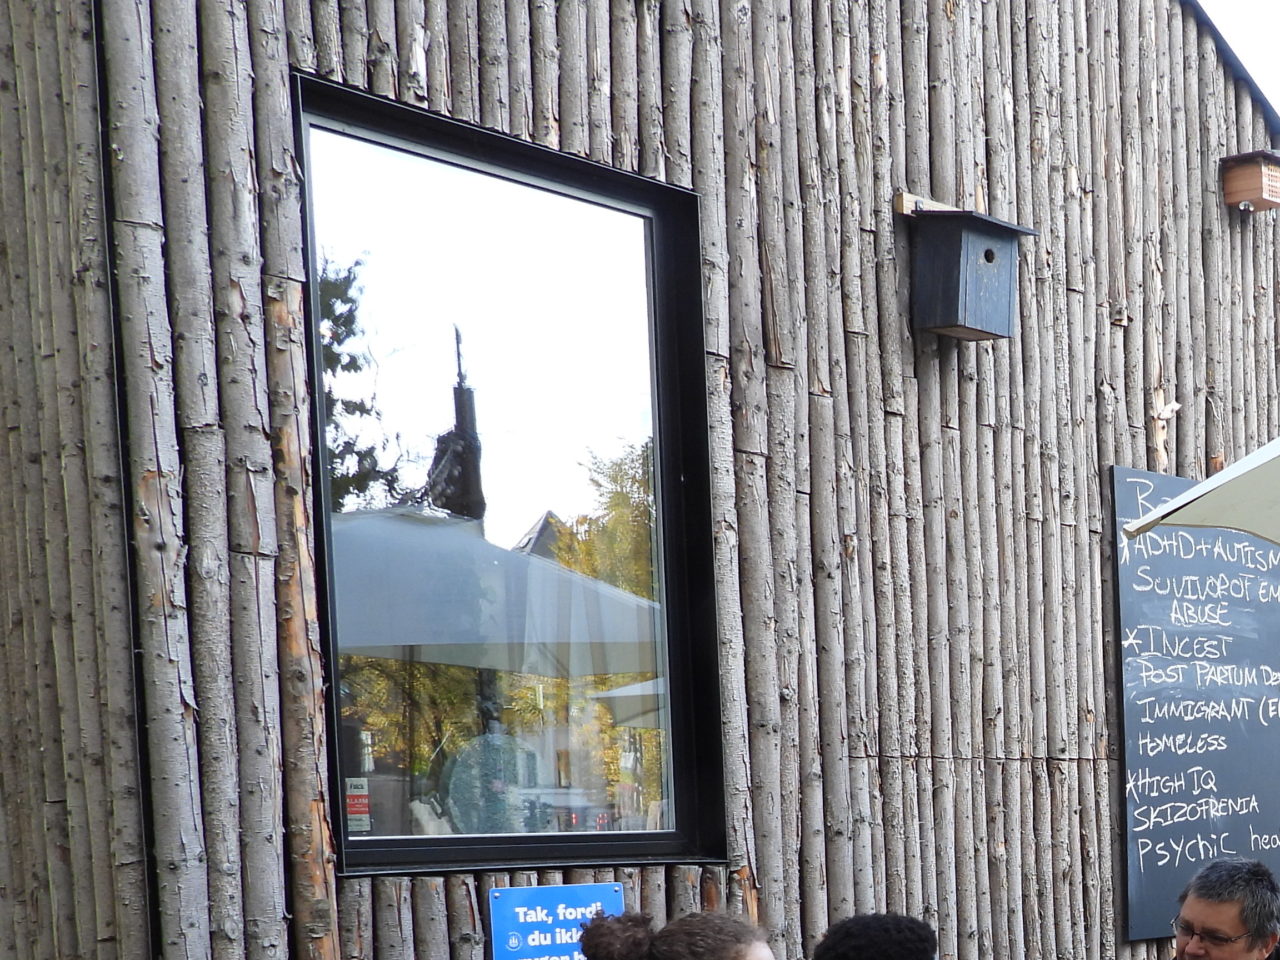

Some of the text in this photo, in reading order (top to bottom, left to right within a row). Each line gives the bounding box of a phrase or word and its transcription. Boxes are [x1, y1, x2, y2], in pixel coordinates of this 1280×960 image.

[1170, 599, 1232, 626] ABUSE
[1137, 625, 1233, 658] INCEST
[1190, 661, 1257, 690] PARTUM
[1136, 697, 1255, 724] IMMIGRANT
[1138, 730, 1228, 756] HOMELESS
[1138, 766, 1217, 797] HIGH IQ
[515, 906, 553, 924] Tak,
[527, 928, 584, 946] du ikk
